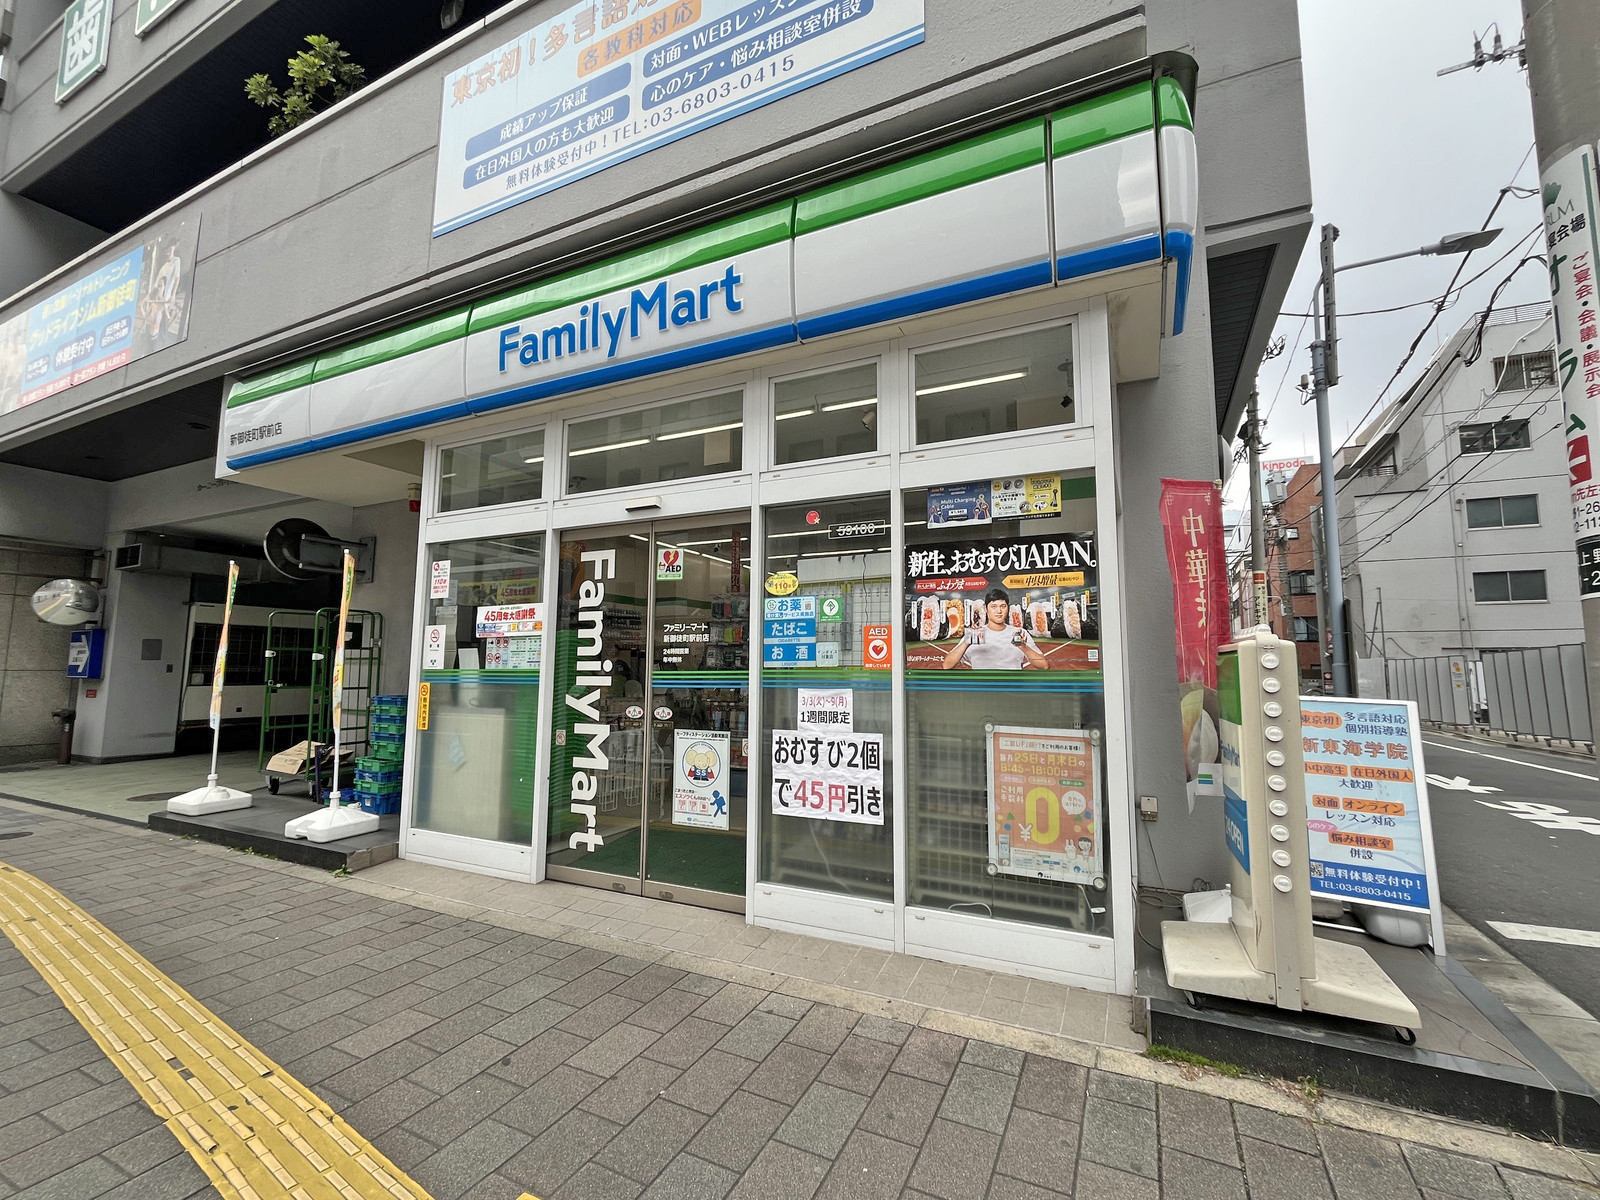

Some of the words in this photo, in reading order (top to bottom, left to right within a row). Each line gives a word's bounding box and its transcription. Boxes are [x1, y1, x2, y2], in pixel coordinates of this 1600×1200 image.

[582, 2, 694, 72] 各教科対応
[499, 87, 588, 142] 成績アップ保証
[475, 105, 614, 181] 在日外国人の方も大歓迎
[499, 261, 744, 373] FamilyMart
[230, 422, 282, 446] 新御徒町駅前店
[665, 564, 682, 573] AED
[937, 578, 965, 590] ふわうま
[778, 599, 802, 611] お薬
[484, 608, 536, 621] 45周年大感謝祭
[663, 623, 708, 632] ファミリーマート
[772, 621, 808, 636] たばこ
[868, 627, 888, 636] AED
[663, 633, 710, 643] 新御徒町駅前店
[565, 549, 616, 852] FamilyMart
[800, 710, 851, 724] 1週間限定
[1344, 711, 1407, 725] 多言語対応
[1345, 723, 1408, 736] 個別指導塾
[1302, 737, 1408, 760] 新東海学院
[1353, 767, 1411, 781] 在日外国人
[1001, 785, 1024, 795] ご利用
[1338, 778, 1374, 791] 大歓迎
[774, 778, 881, 817] で45円引き
[1316, 796, 1338, 808] 対面
[1345, 800, 1404, 814] オンライン
[1326, 810, 1396, 827] レッスン対応
[1331, 832, 1391, 849] 悩み相談室
[1350, 848, 1374, 860] 併設
[1318, 879, 1412, 901] TEL:03-6803-0415
